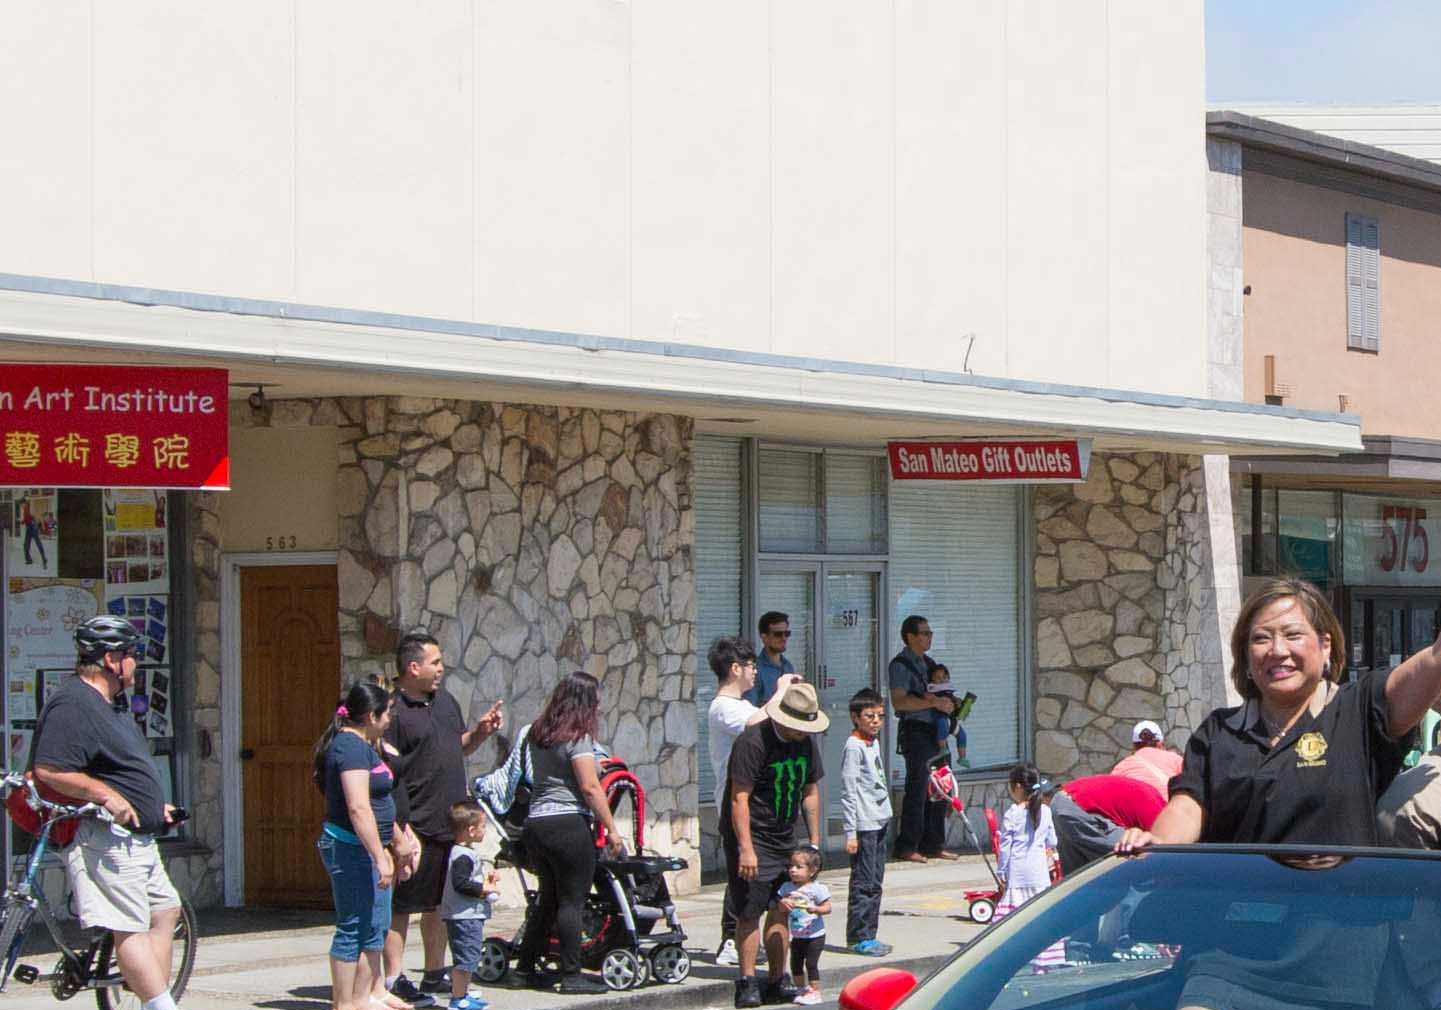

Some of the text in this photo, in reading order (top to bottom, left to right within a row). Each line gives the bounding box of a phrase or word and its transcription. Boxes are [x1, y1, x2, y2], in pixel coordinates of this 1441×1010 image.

[24, 386, 74, 411] Art
[84, 386, 215, 413] Institute
[5, 431, 190, 469] 藝術學院
[898, 446, 1072, 473] San Mateo Gift Outlets
[265, 535, 297, 551] 563
[1379, 505, 1430, 574] 575
